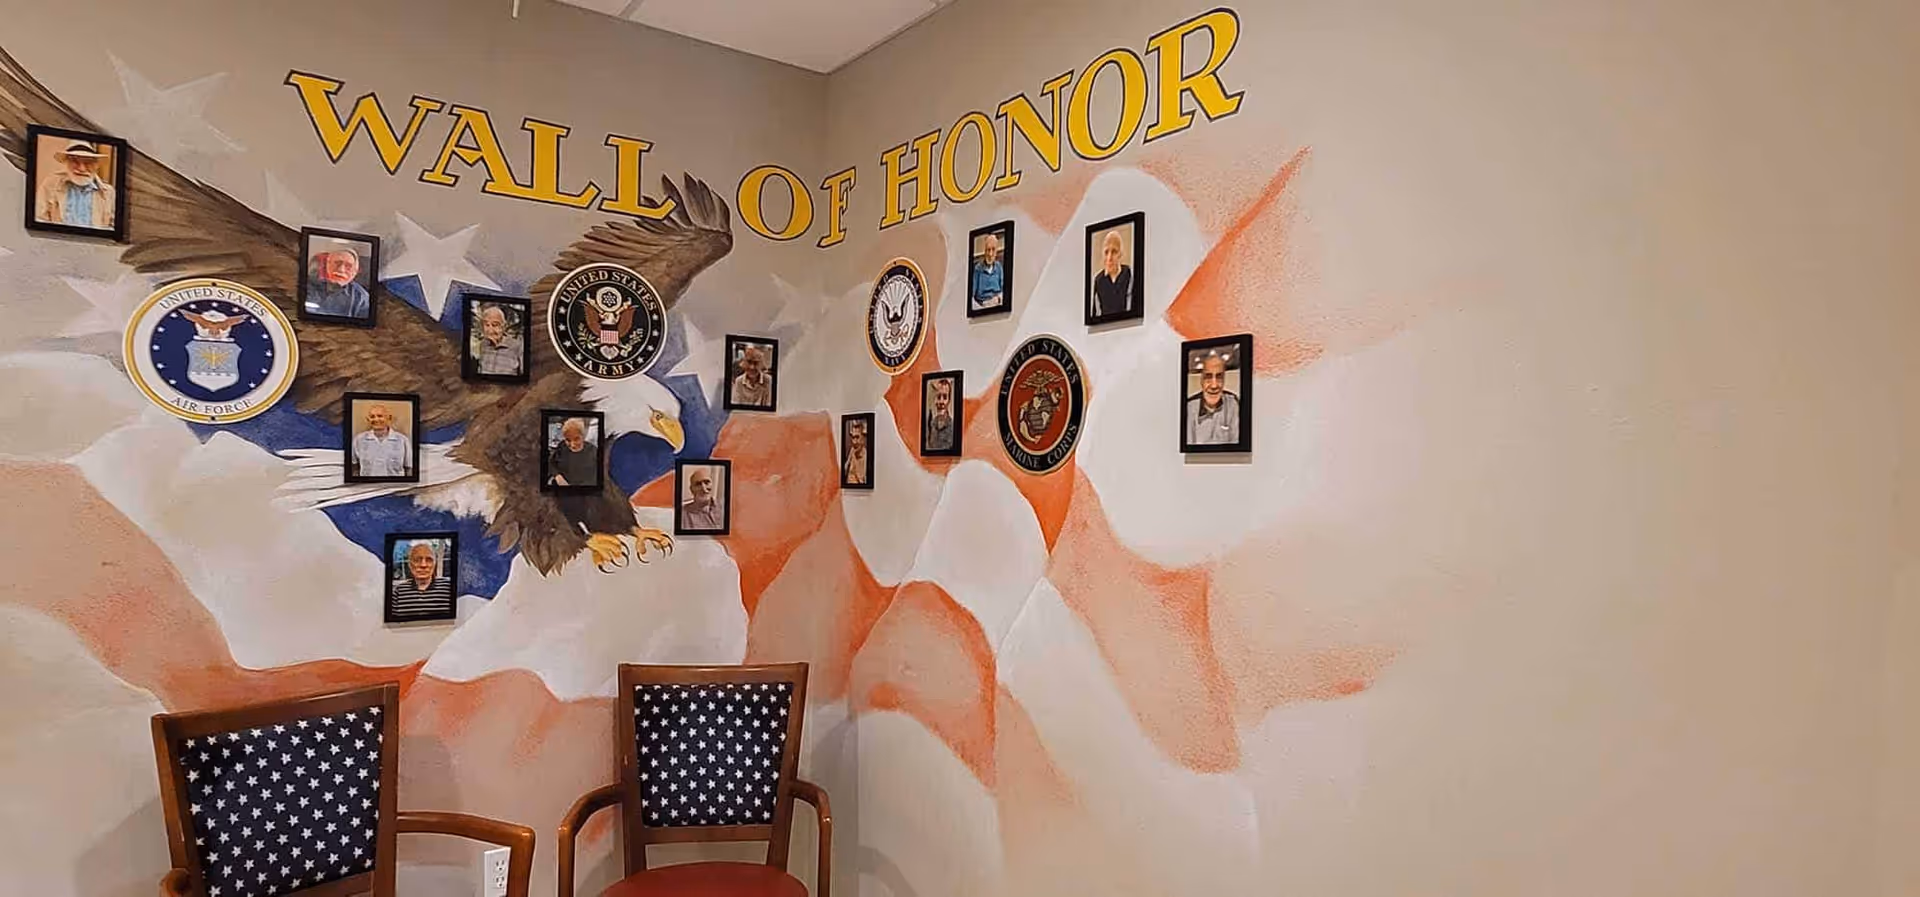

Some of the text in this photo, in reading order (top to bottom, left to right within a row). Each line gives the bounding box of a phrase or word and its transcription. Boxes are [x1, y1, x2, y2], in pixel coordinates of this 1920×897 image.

[283, 6, 1245, 248] WALL OF HONOR
[159, 287, 267, 317] UNITED STATES
[560, 270, 657, 311] UNITED STATES
[583, 360, 635, 376] ARMY
[1001, 341, 1079, 396] UNITED STATES
[170, 397, 252, 415] AIR FORCE
[1004, 422, 1077, 468] MARINE CORPS
